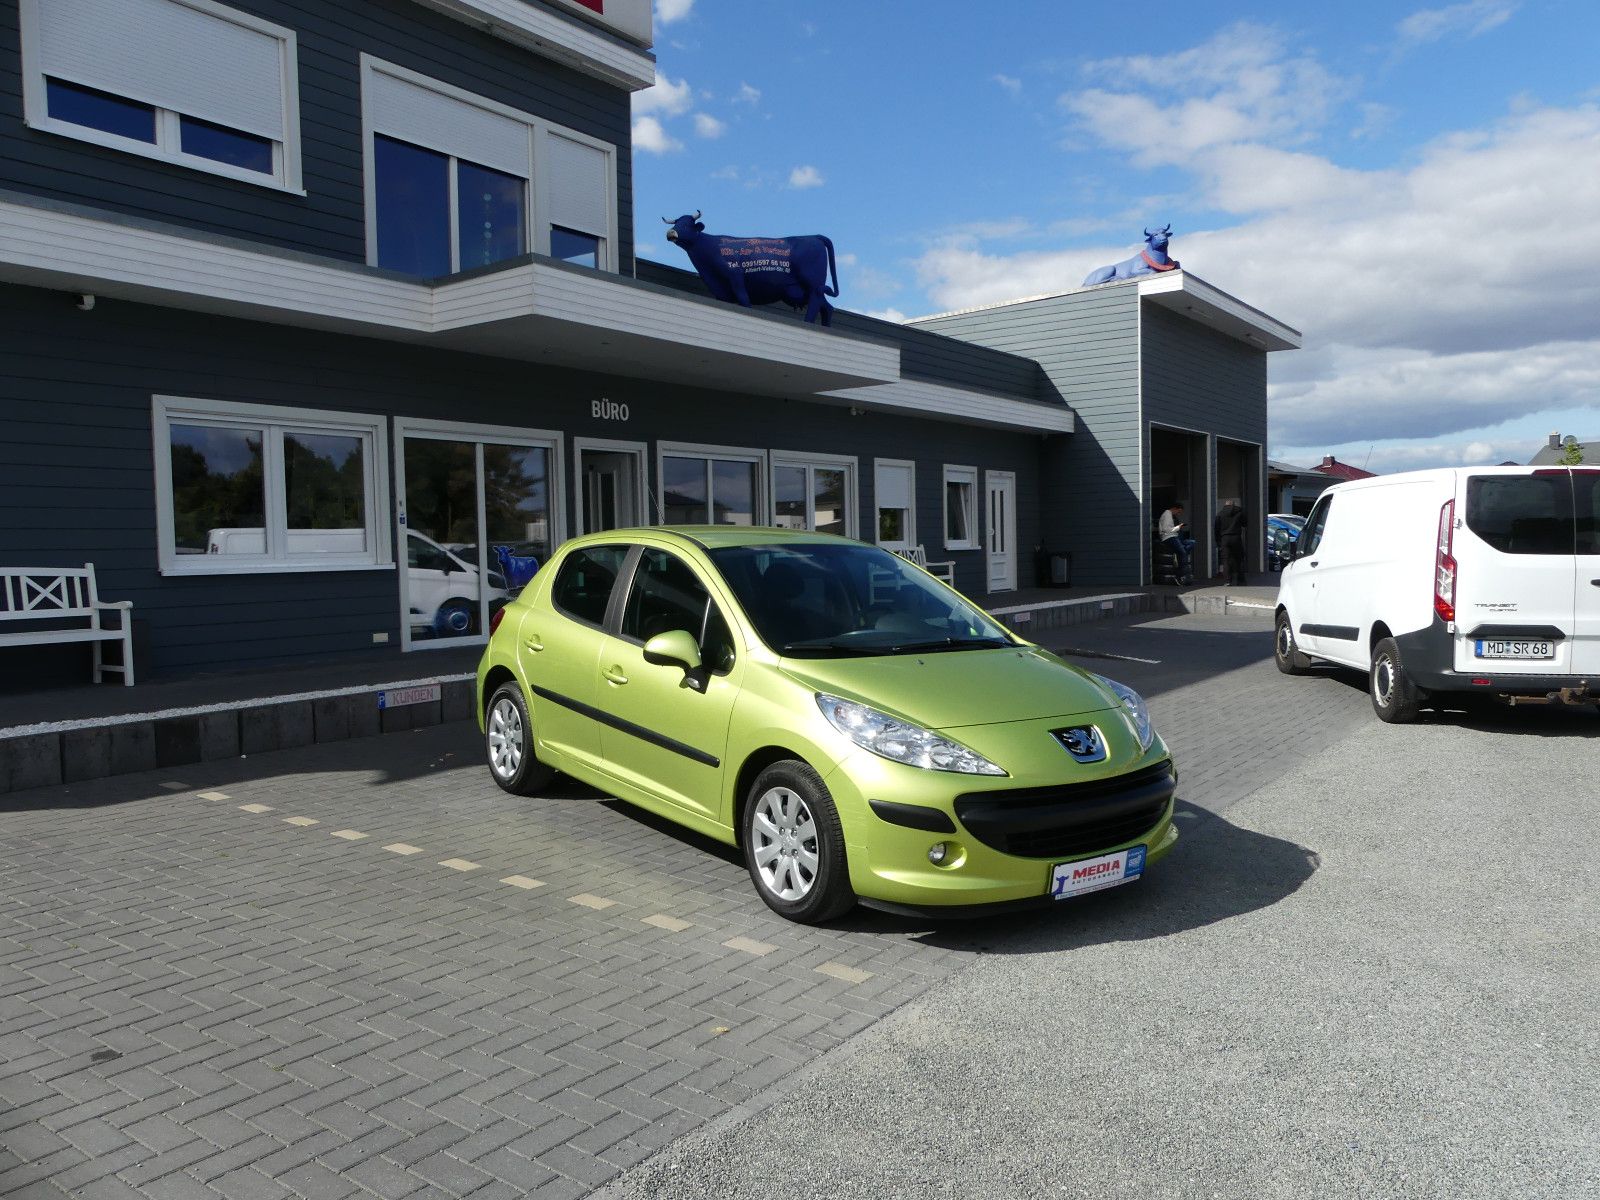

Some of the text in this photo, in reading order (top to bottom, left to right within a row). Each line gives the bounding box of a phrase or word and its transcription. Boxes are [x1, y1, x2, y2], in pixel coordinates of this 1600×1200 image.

[591, 397, 629, 421] BÜRO
[1487, 642, 1548, 655] MD SR 68
[392, 687, 434, 705] KUNDEN
[1072, 870, 1120, 885] AUTOHANDEL
[1073, 860, 1120, 880] MEDIA
